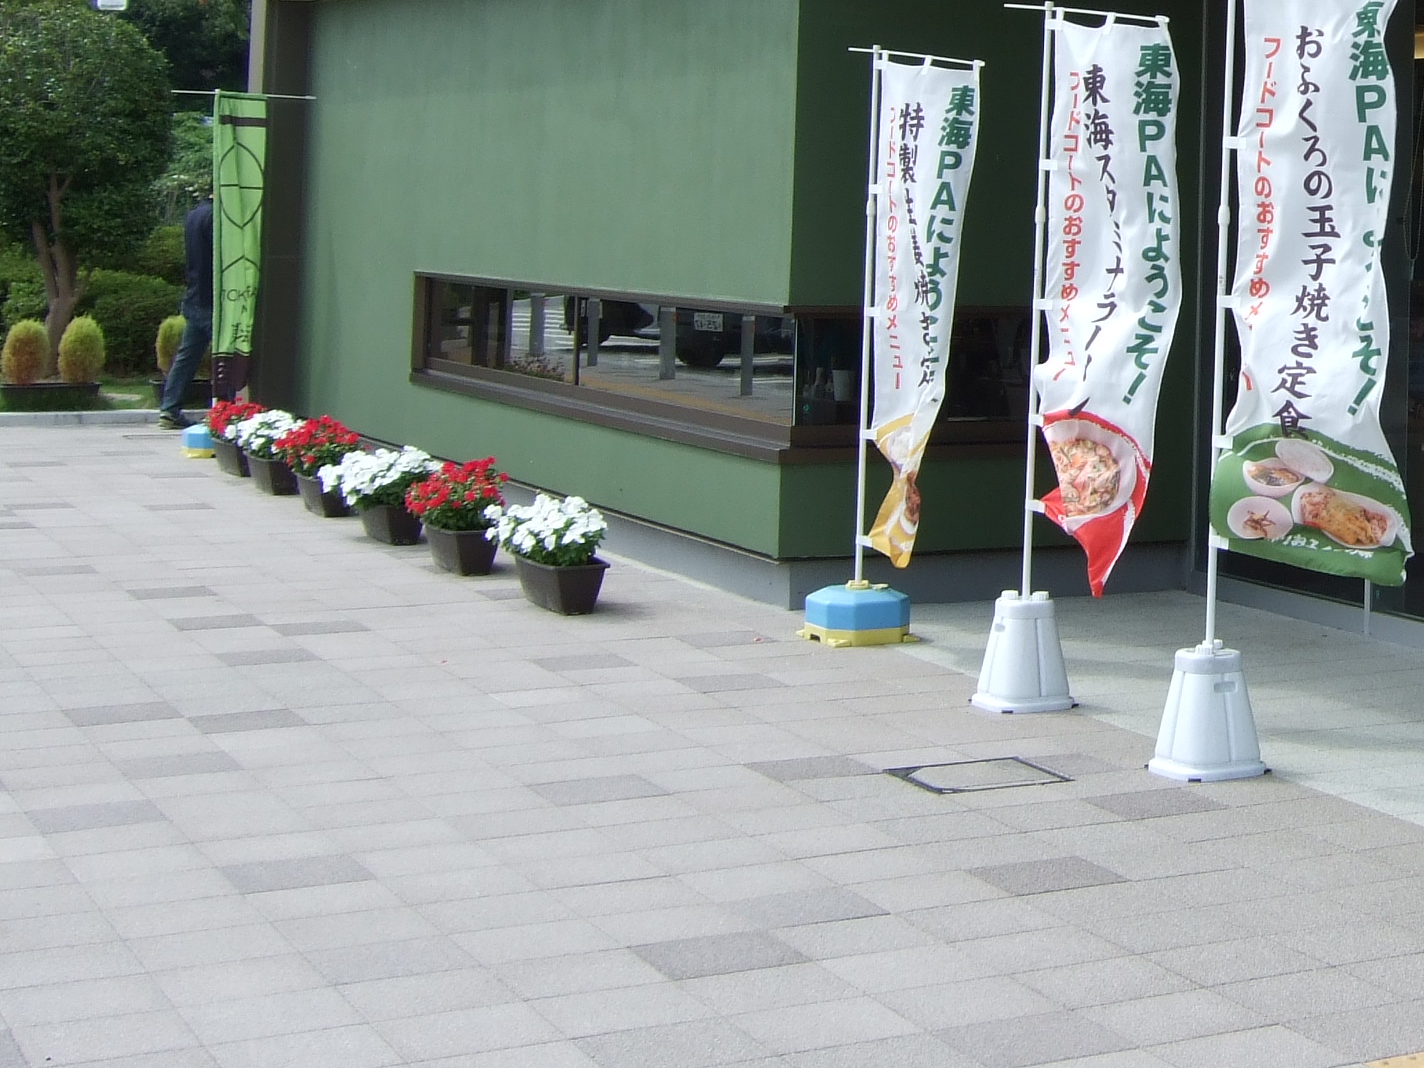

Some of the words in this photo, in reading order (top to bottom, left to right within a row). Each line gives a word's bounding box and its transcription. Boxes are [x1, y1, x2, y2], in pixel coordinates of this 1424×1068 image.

[1068, 64, 1125, 417] 東海スタミナラー
[1123, 43, 1173, 405] 東海PAにようこそ!
[1242, 37, 1282, 391] フードコートのおすすめメー
[1271, 25, 1342, 440] おふくろの玉子焼き定食
[1347, 1, 1390, 416] 東海PAにこそ!
